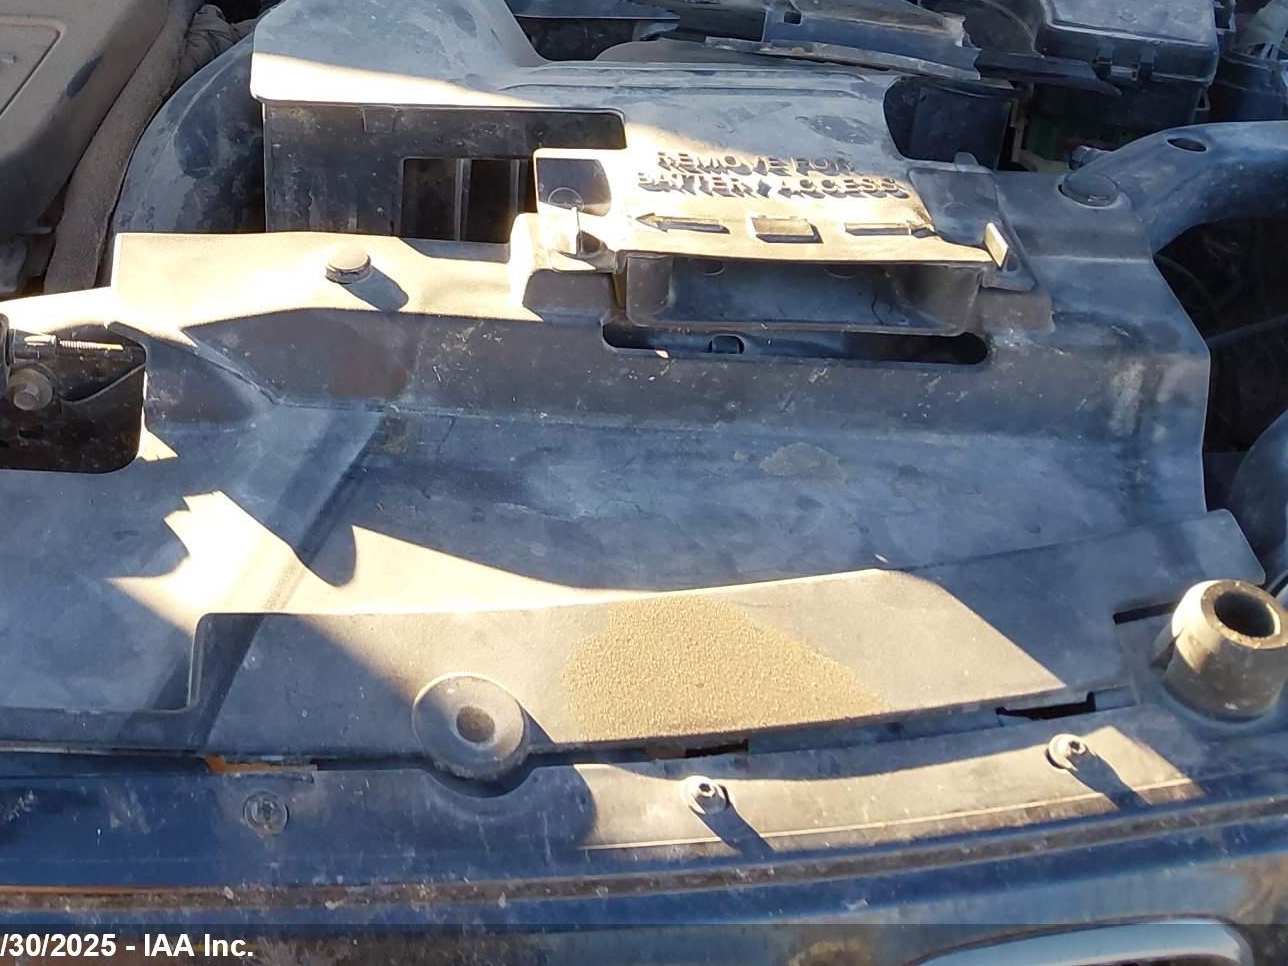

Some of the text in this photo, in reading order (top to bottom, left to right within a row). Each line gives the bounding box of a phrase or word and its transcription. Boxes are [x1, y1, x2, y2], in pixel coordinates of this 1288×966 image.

[656, 151, 856, 175] REMOVE FOR
[779, 177, 904, 197] ACCESS
